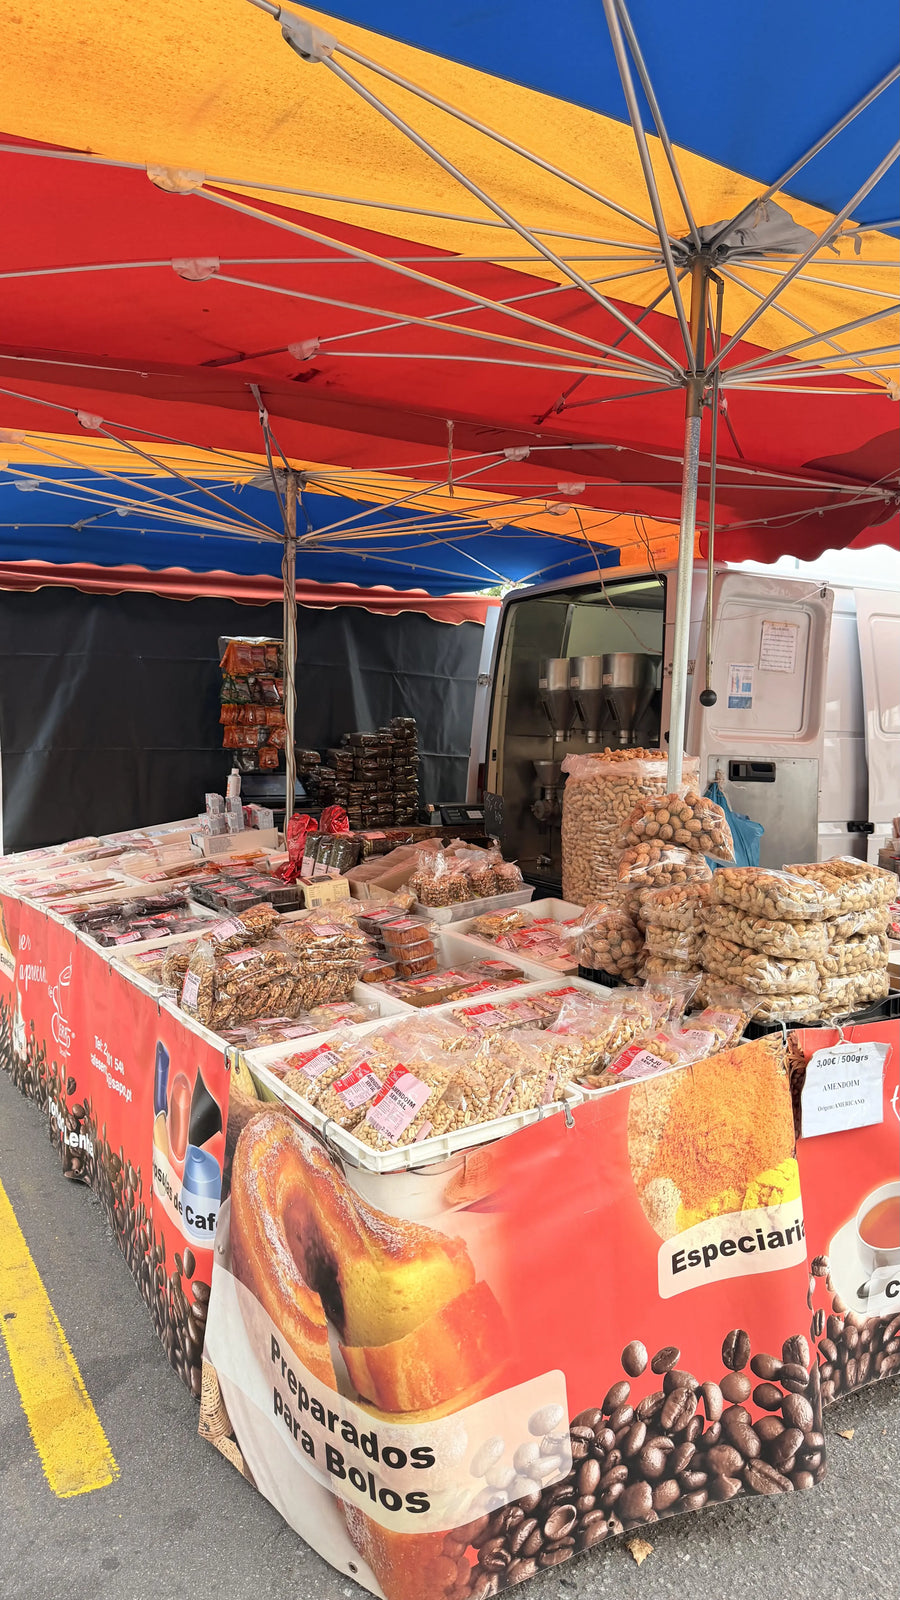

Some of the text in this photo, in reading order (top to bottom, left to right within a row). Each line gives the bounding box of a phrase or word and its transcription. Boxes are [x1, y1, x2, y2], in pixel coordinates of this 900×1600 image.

[645, 1055, 662, 1066] CAJU
[816, 1057, 836, 1068] 3,00€
[841, 1054, 869, 1064] 500grs
[822, 1079, 860, 1092] AMENDOIM
[389, 1092, 407, 1111] SEM SAL
[391, 1085, 416, 1109] AMENDOIM
[185, 1205, 217, 1231] Caf
[270, 1333, 436, 1470] Preparados
[273, 1387, 431, 1515] para Bolos
